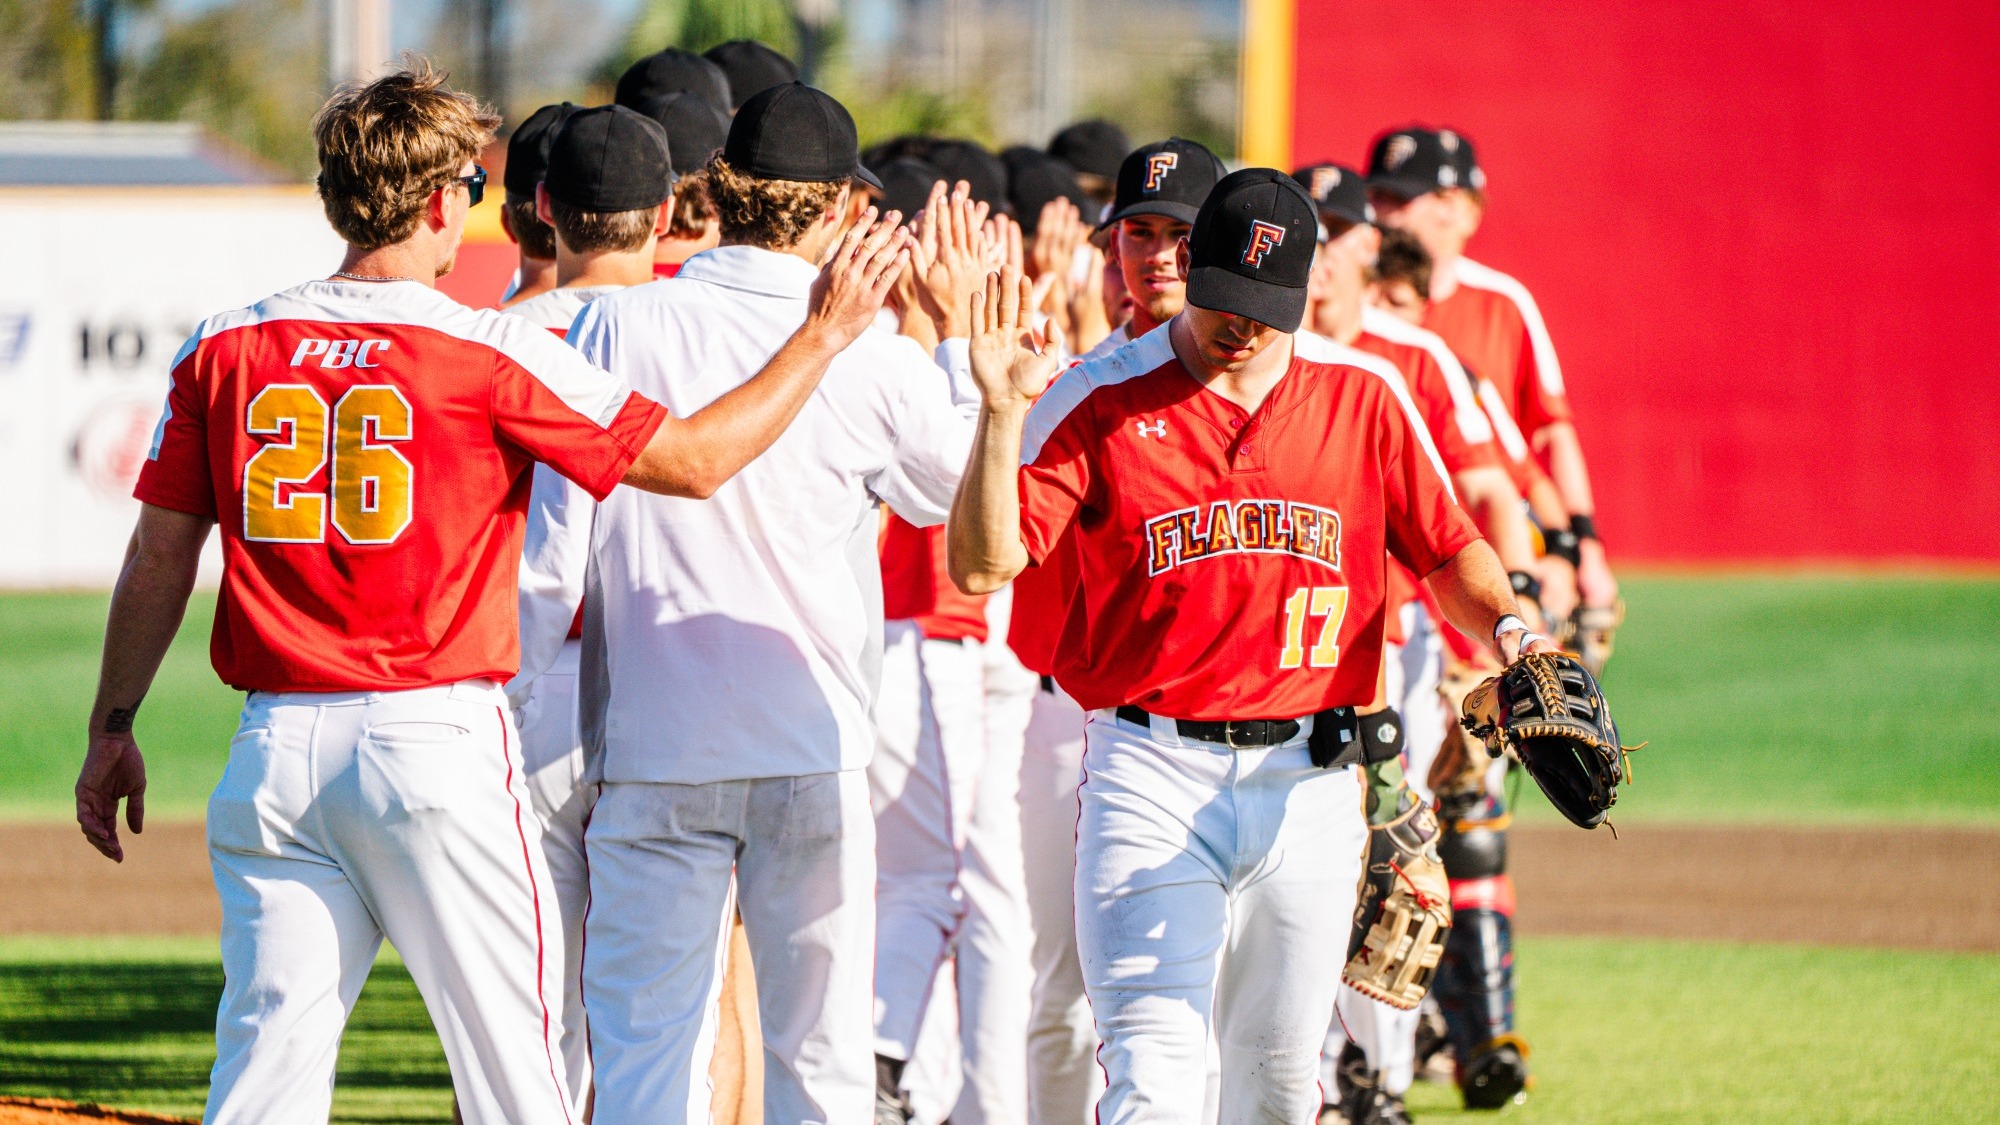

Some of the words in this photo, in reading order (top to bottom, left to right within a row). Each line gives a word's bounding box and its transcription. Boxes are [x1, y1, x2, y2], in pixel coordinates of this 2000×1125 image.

[1143, 152, 1178, 193] F
[1241, 219, 1286, 269] F
[290, 338, 391, 369] PBC
[243, 384, 414, 544] 26
[1145, 499, 1342, 578] FLAGLER
[1279, 586, 1349, 669] 17
